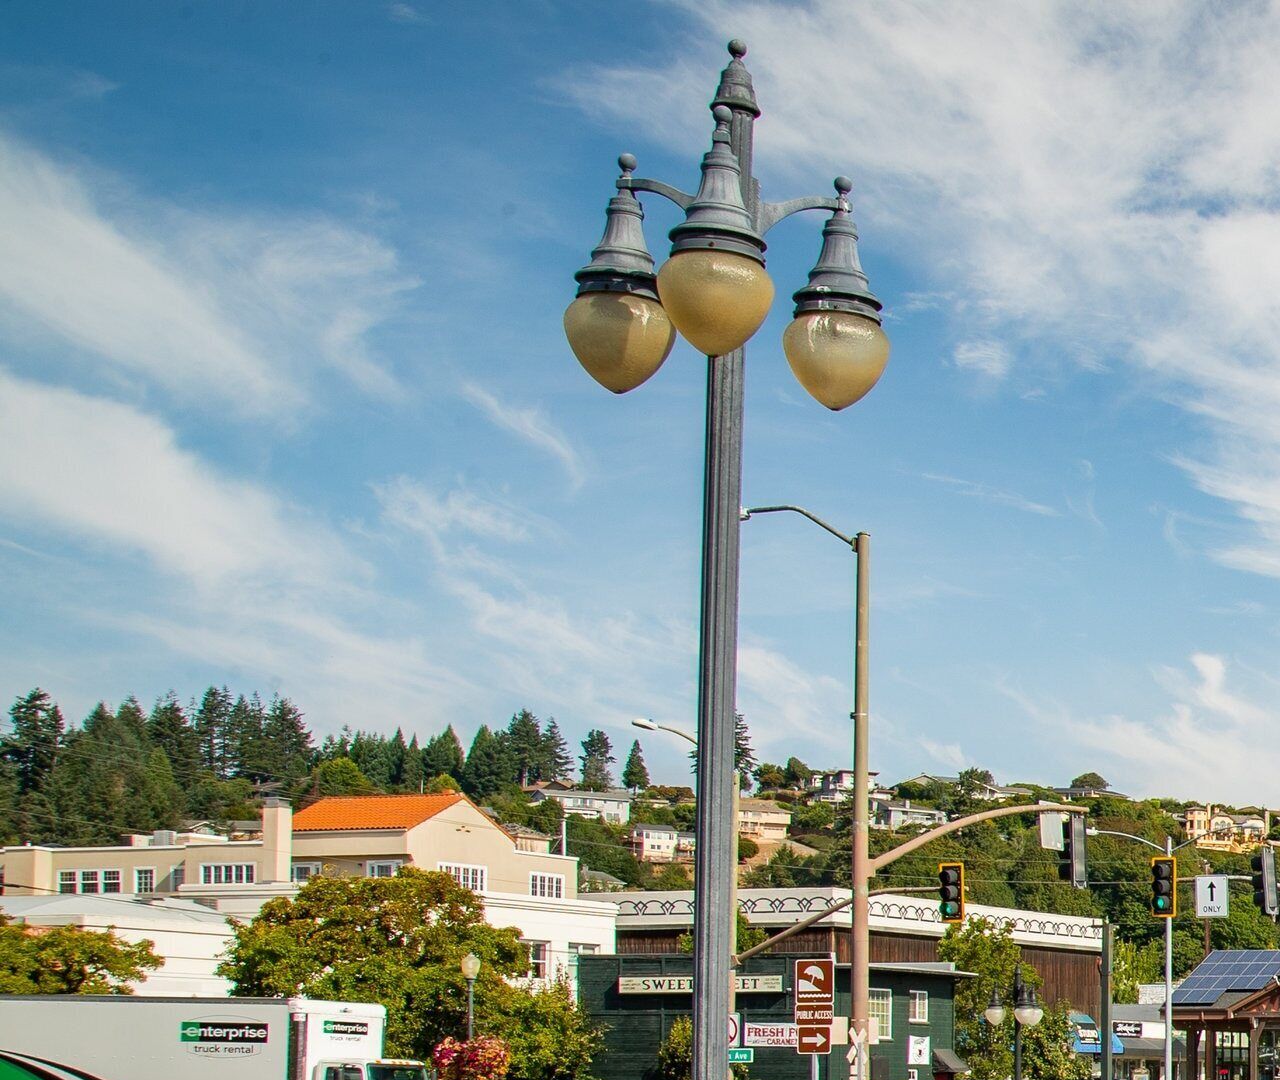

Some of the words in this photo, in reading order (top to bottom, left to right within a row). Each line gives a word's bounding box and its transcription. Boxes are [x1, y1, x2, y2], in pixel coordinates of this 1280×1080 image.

[1203, 905, 1221, 913] ONLY
[642, 979, 694, 990] SWEET
[796, 1010, 813, 1019] PUBLIC
[814, 1010, 833, 1019] ACCESS
[182, 1025, 268, 1041] enterprise
[324, 1023, 368, 1034] enterprise
[747, 1027, 785, 1038] FRESH
[194, 1045, 221, 1054] truck
[224, 1045, 254, 1054] rental
[734, 1051, 748, 1060] Ave
